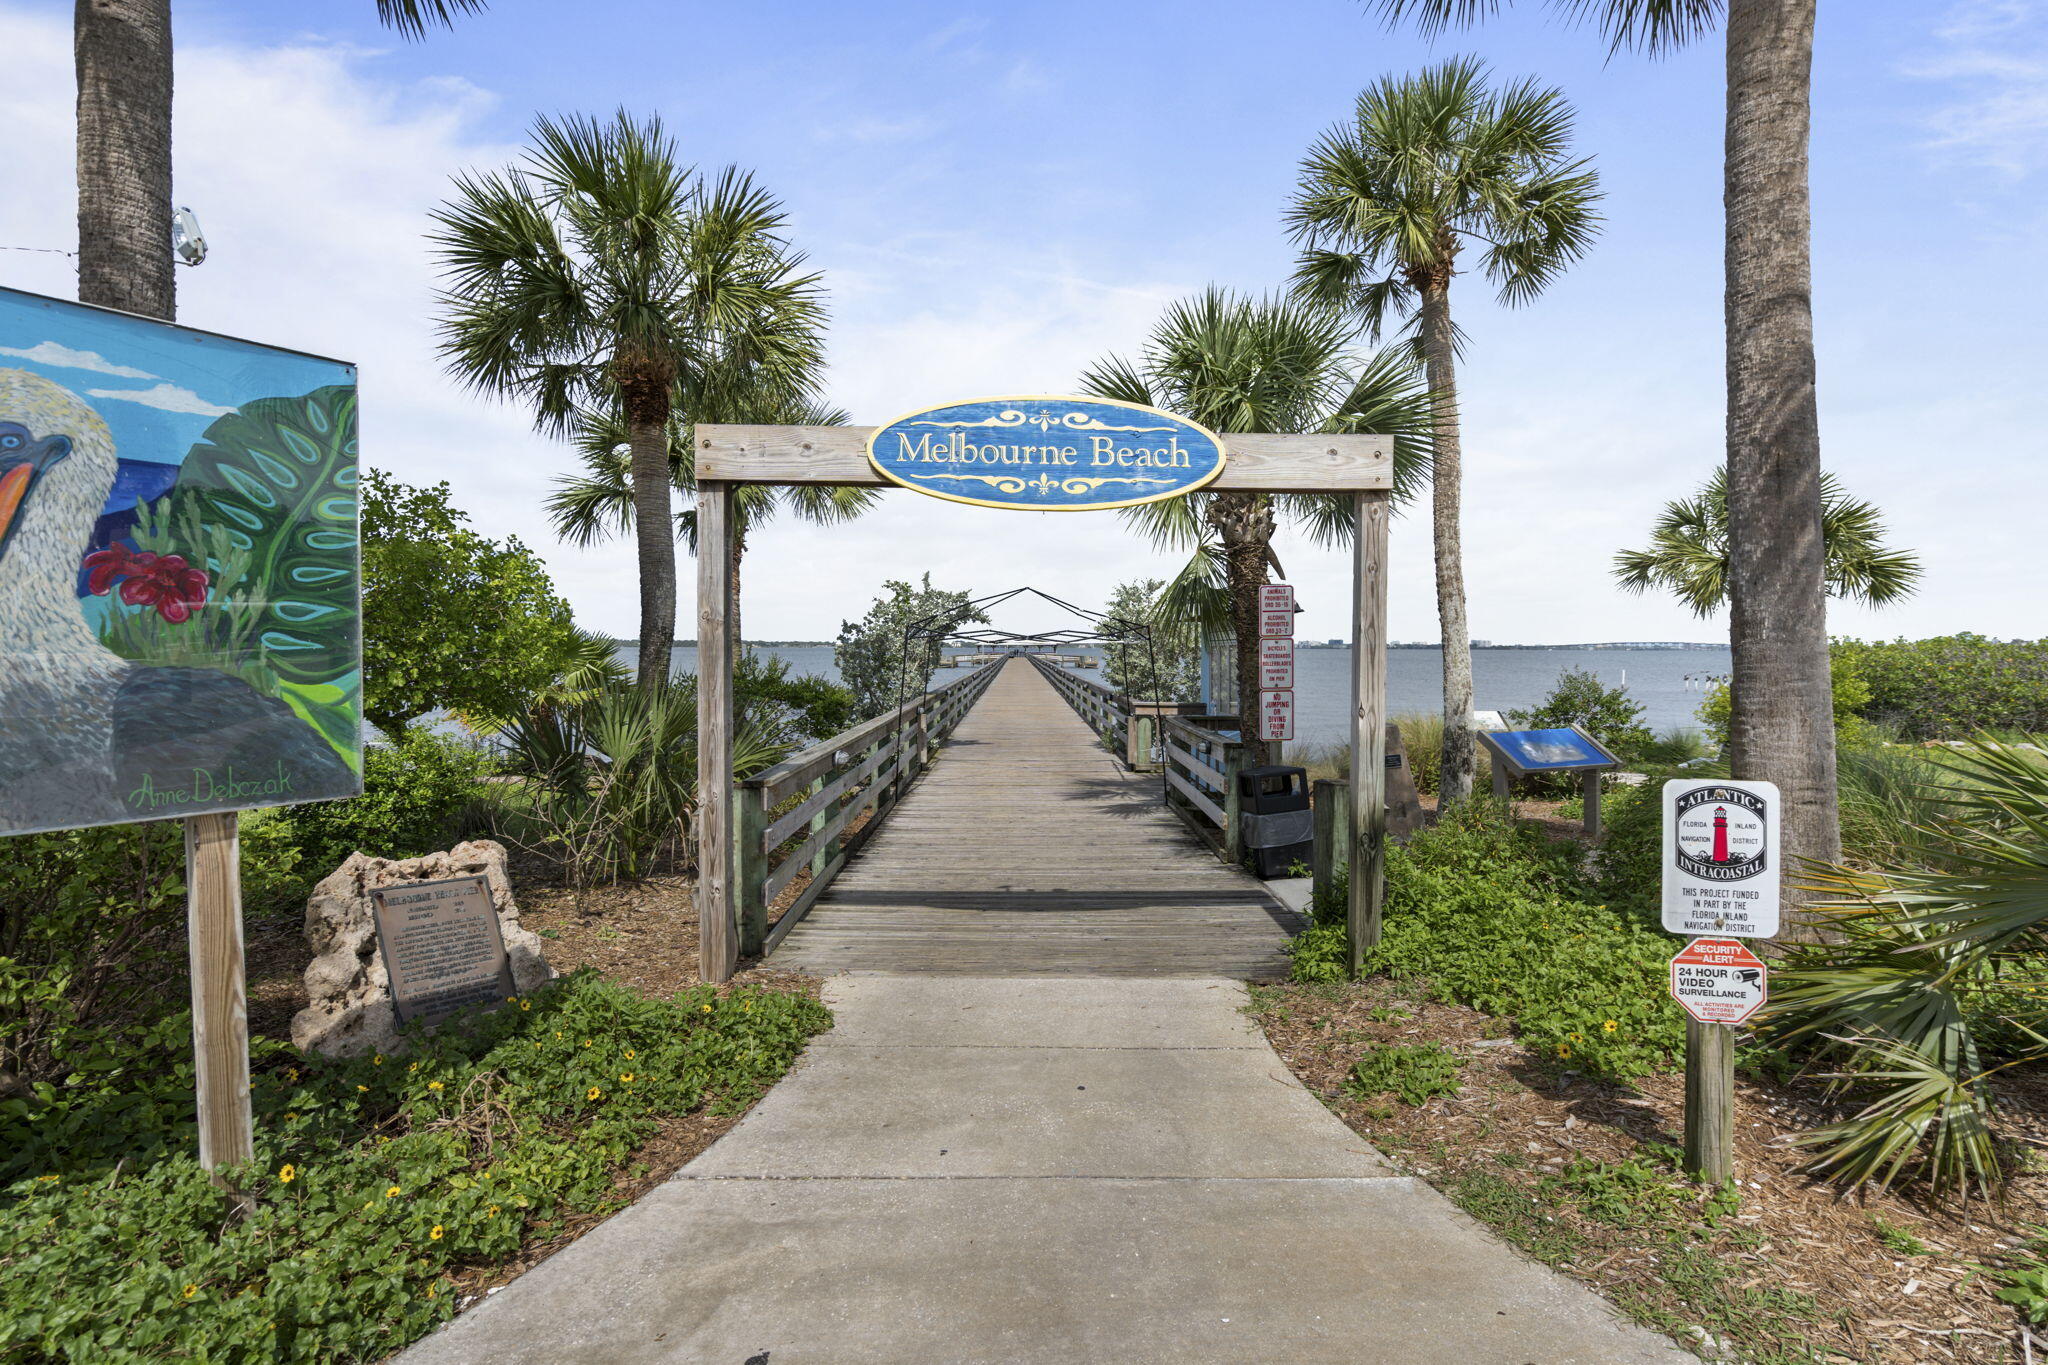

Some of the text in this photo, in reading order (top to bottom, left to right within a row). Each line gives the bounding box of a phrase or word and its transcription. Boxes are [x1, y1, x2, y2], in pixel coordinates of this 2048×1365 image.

[896, 429, 1191, 468] Melbourne Beach
[128, 760, 294, 808] Anne Debczak
[1687, 788, 1755, 809] ATLANTIC
[1680, 856, 1762, 879] INTRACOASTAL
[1682, 888, 1759, 899] THIS PROJECT FUNDED
[1704, 900, 1720, 908] PART
[1734, 901, 1746, 910] THE
[1723, 913, 1748, 921] INLAND
[1684, 921, 1754, 932] NAVIGATION DISTRICT
[1694, 945, 1742, 955] SECURITY
[1703, 955, 1734, 963] ALERT
[1679, 968, 1728, 978] 24 HOUR
[1679, 978, 1714, 987] VIDEO
[1679, 988, 1746, 998] SURVEILLANCE
